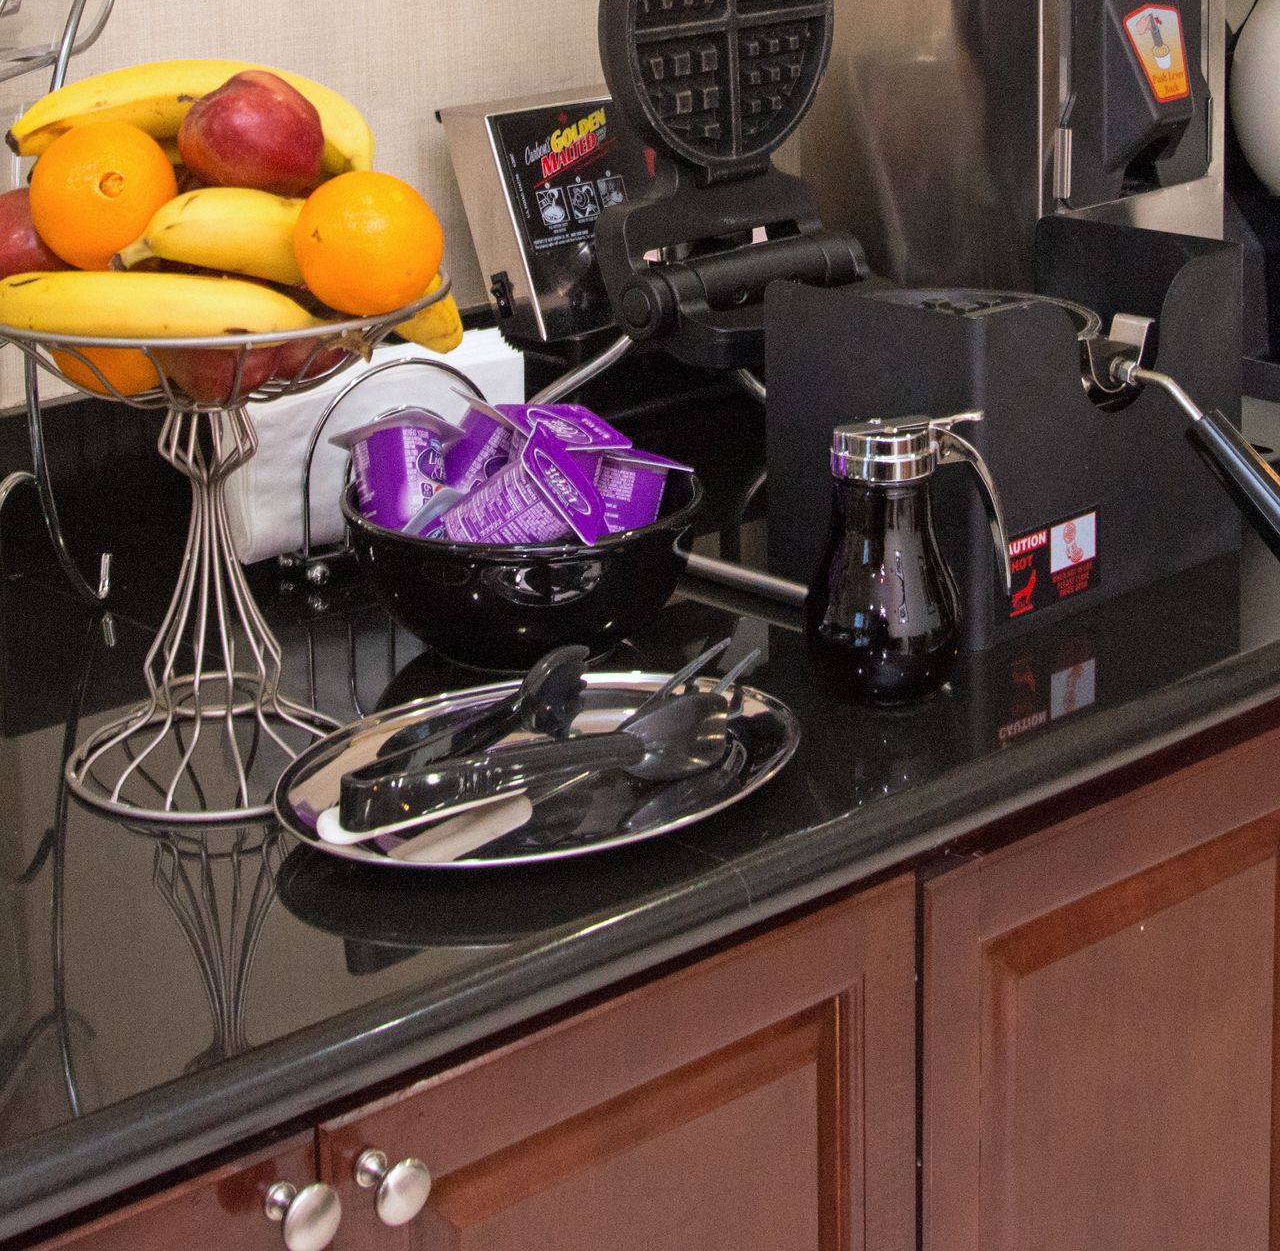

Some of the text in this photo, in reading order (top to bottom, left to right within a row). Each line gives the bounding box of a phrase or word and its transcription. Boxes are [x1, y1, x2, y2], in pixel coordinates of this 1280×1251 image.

[550, 107, 607, 153] GOLDEN
[540, 132, 597, 179] MALTED
[1009, 531, 1047, 556] AUTION
[1011, 554, 1033, 574] HOT
